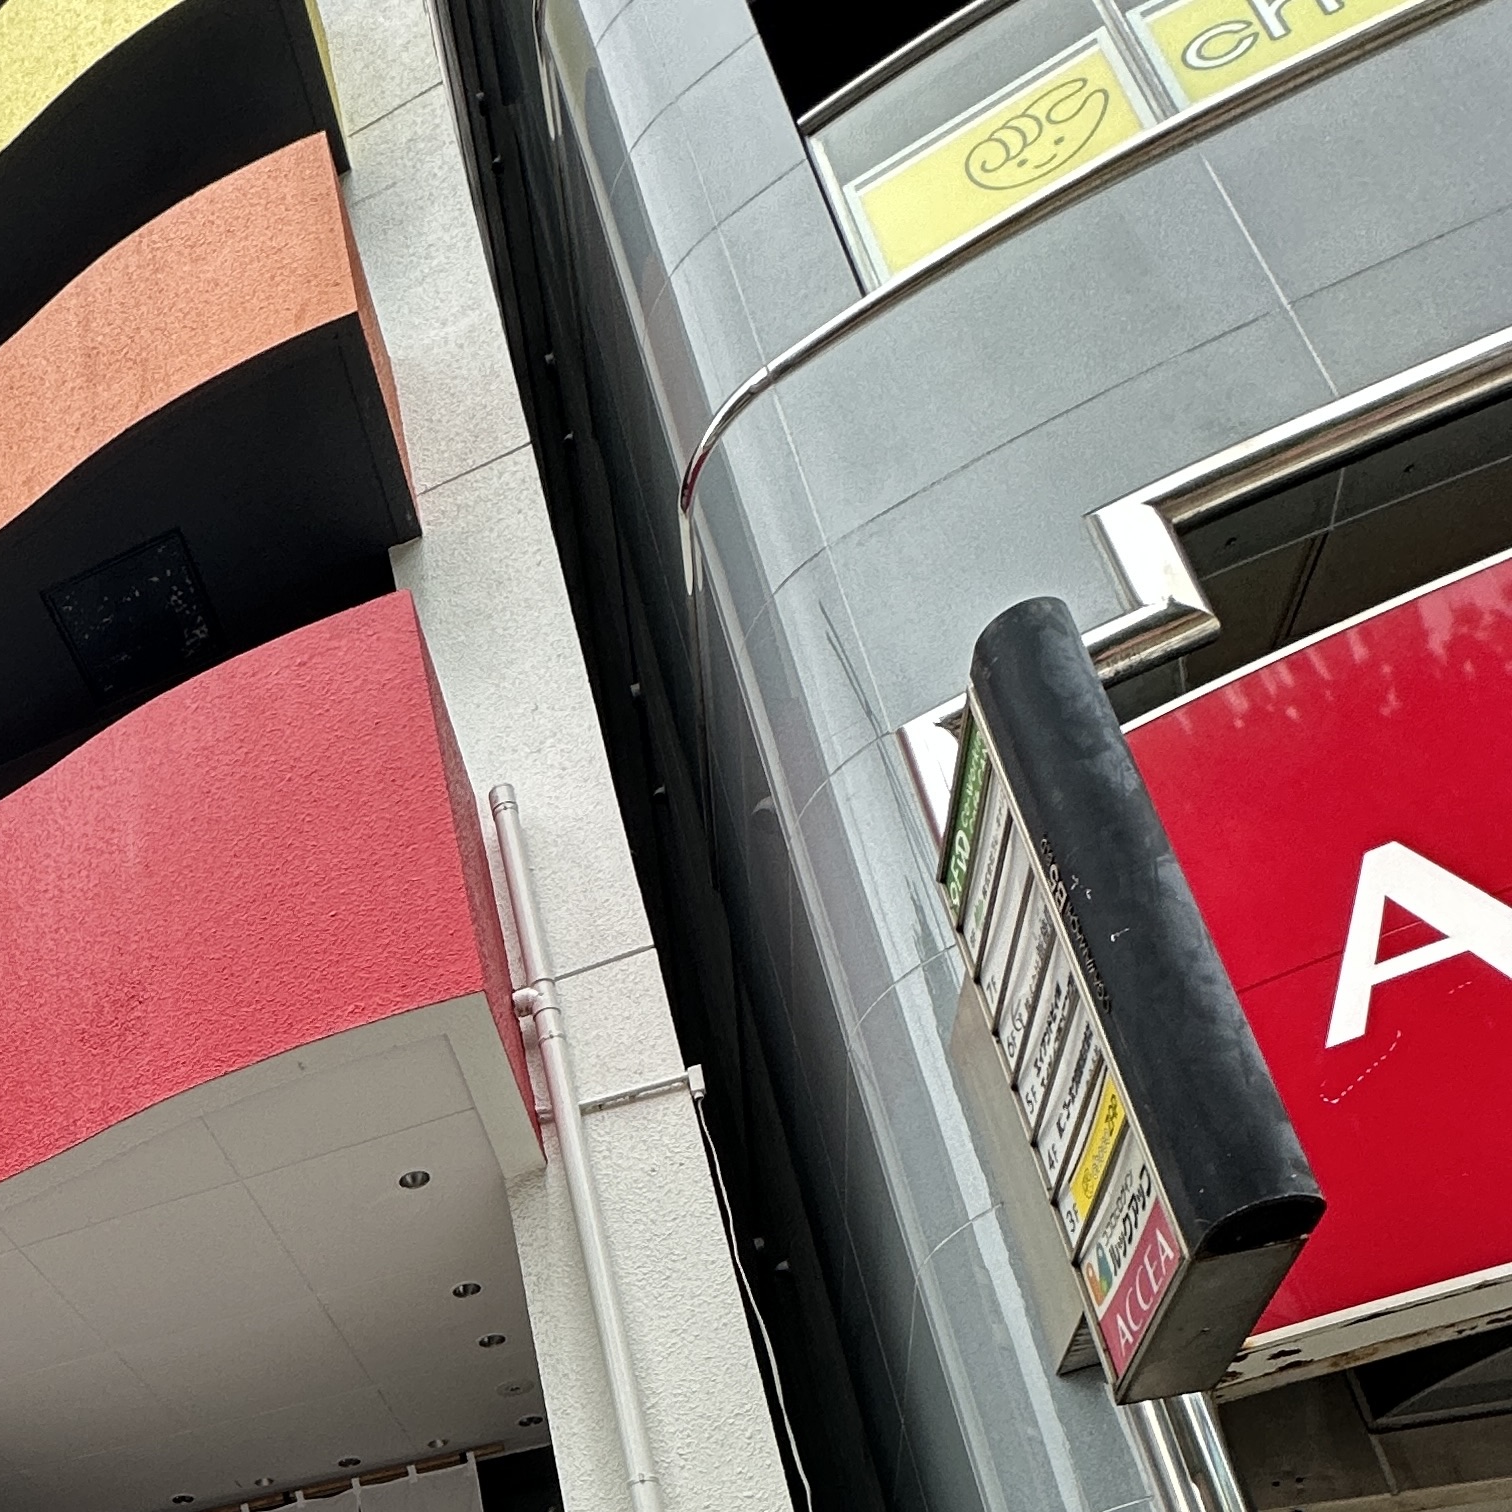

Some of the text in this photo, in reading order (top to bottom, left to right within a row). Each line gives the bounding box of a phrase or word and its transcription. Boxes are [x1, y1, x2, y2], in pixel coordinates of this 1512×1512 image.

[1325, 841, 1512, 1049] A
[1065, 1194, 1080, 1237] 3F
[1115, 1227, 1175, 1357] ACCEA
